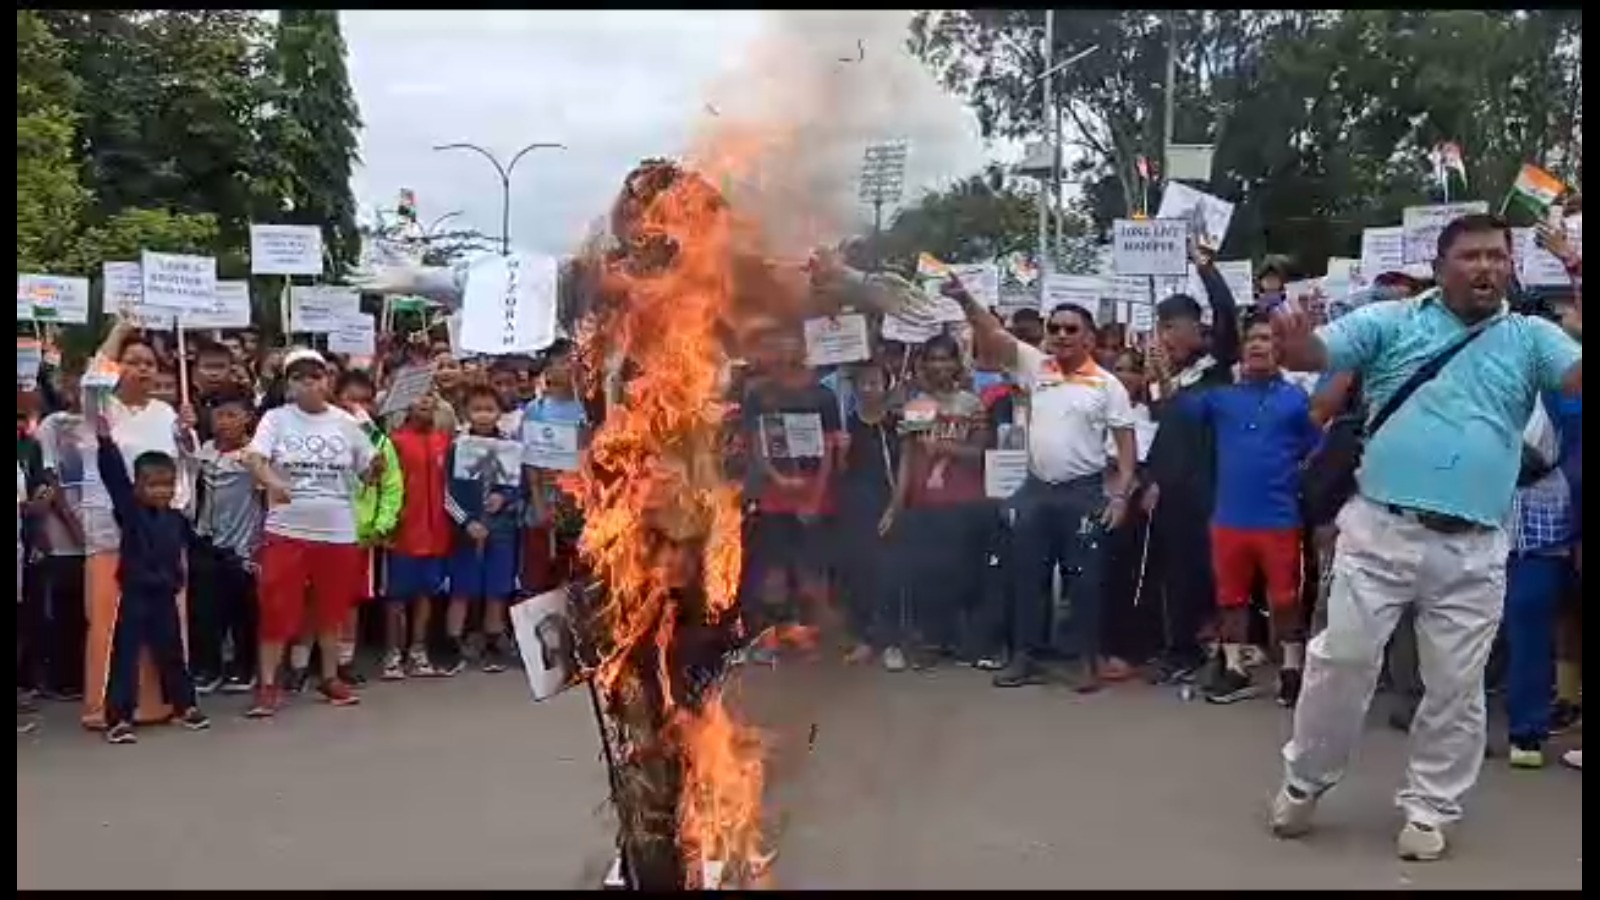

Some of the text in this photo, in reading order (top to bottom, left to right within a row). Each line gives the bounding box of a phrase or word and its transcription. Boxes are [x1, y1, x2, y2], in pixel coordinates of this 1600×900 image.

[1122, 225, 1179, 238] LONG LIVE
[503, 260, 519, 345] MIZORAM
